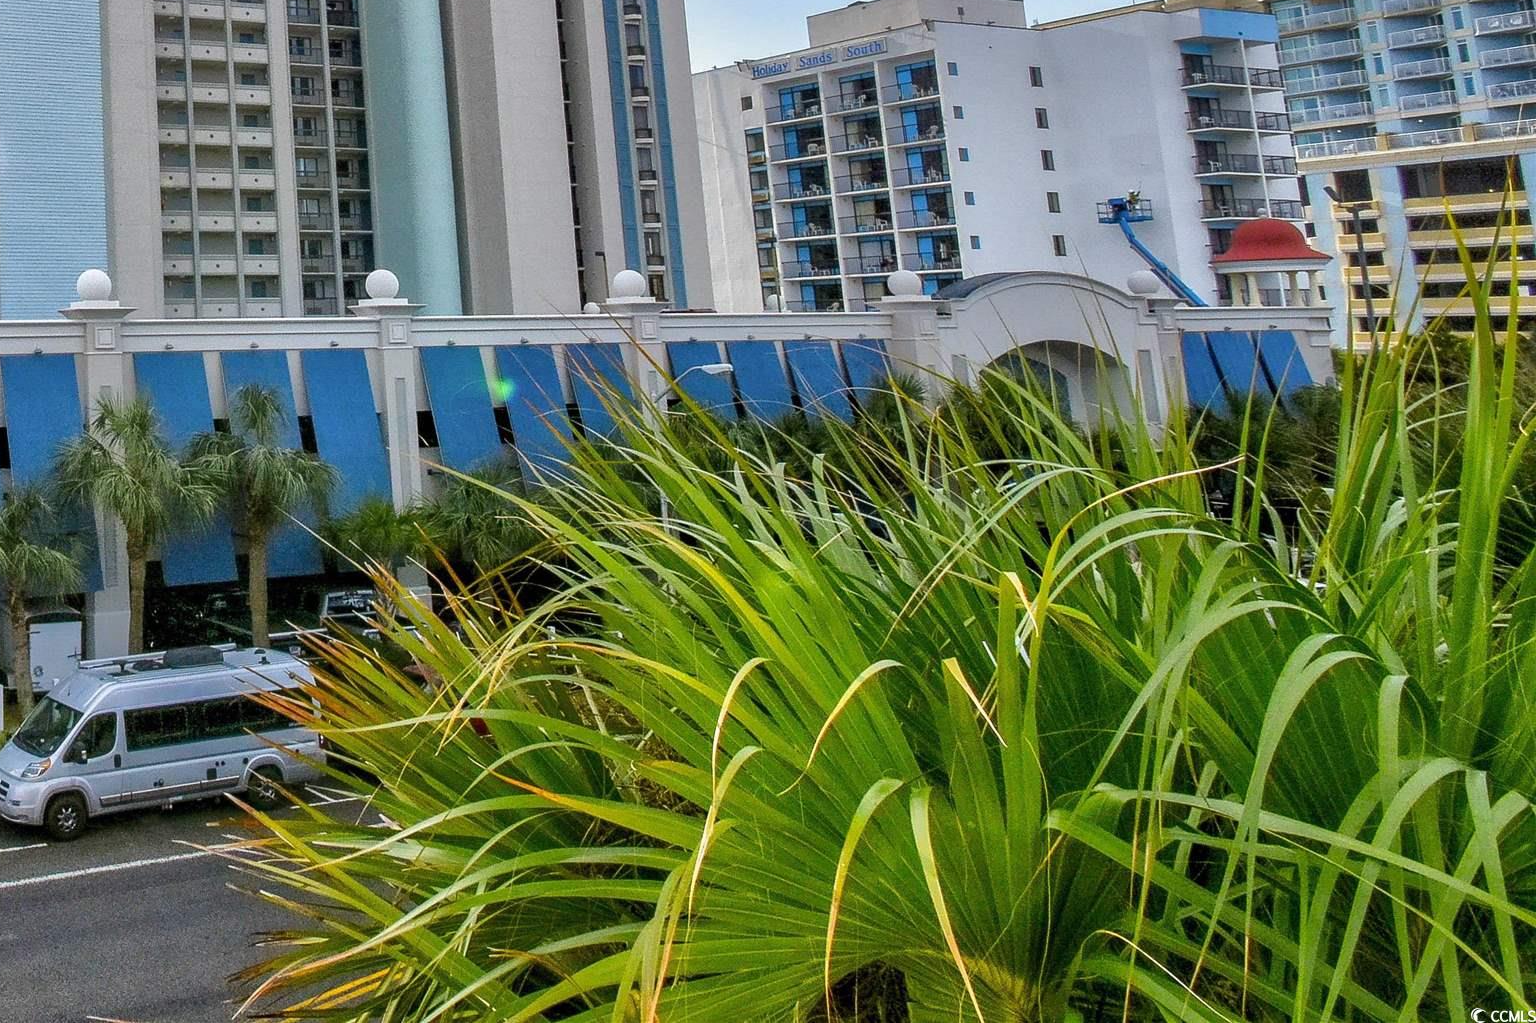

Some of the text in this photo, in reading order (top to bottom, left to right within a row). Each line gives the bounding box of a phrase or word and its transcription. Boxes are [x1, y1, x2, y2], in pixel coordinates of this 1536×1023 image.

[752, 41, 881, 77] Holiday Sands South
